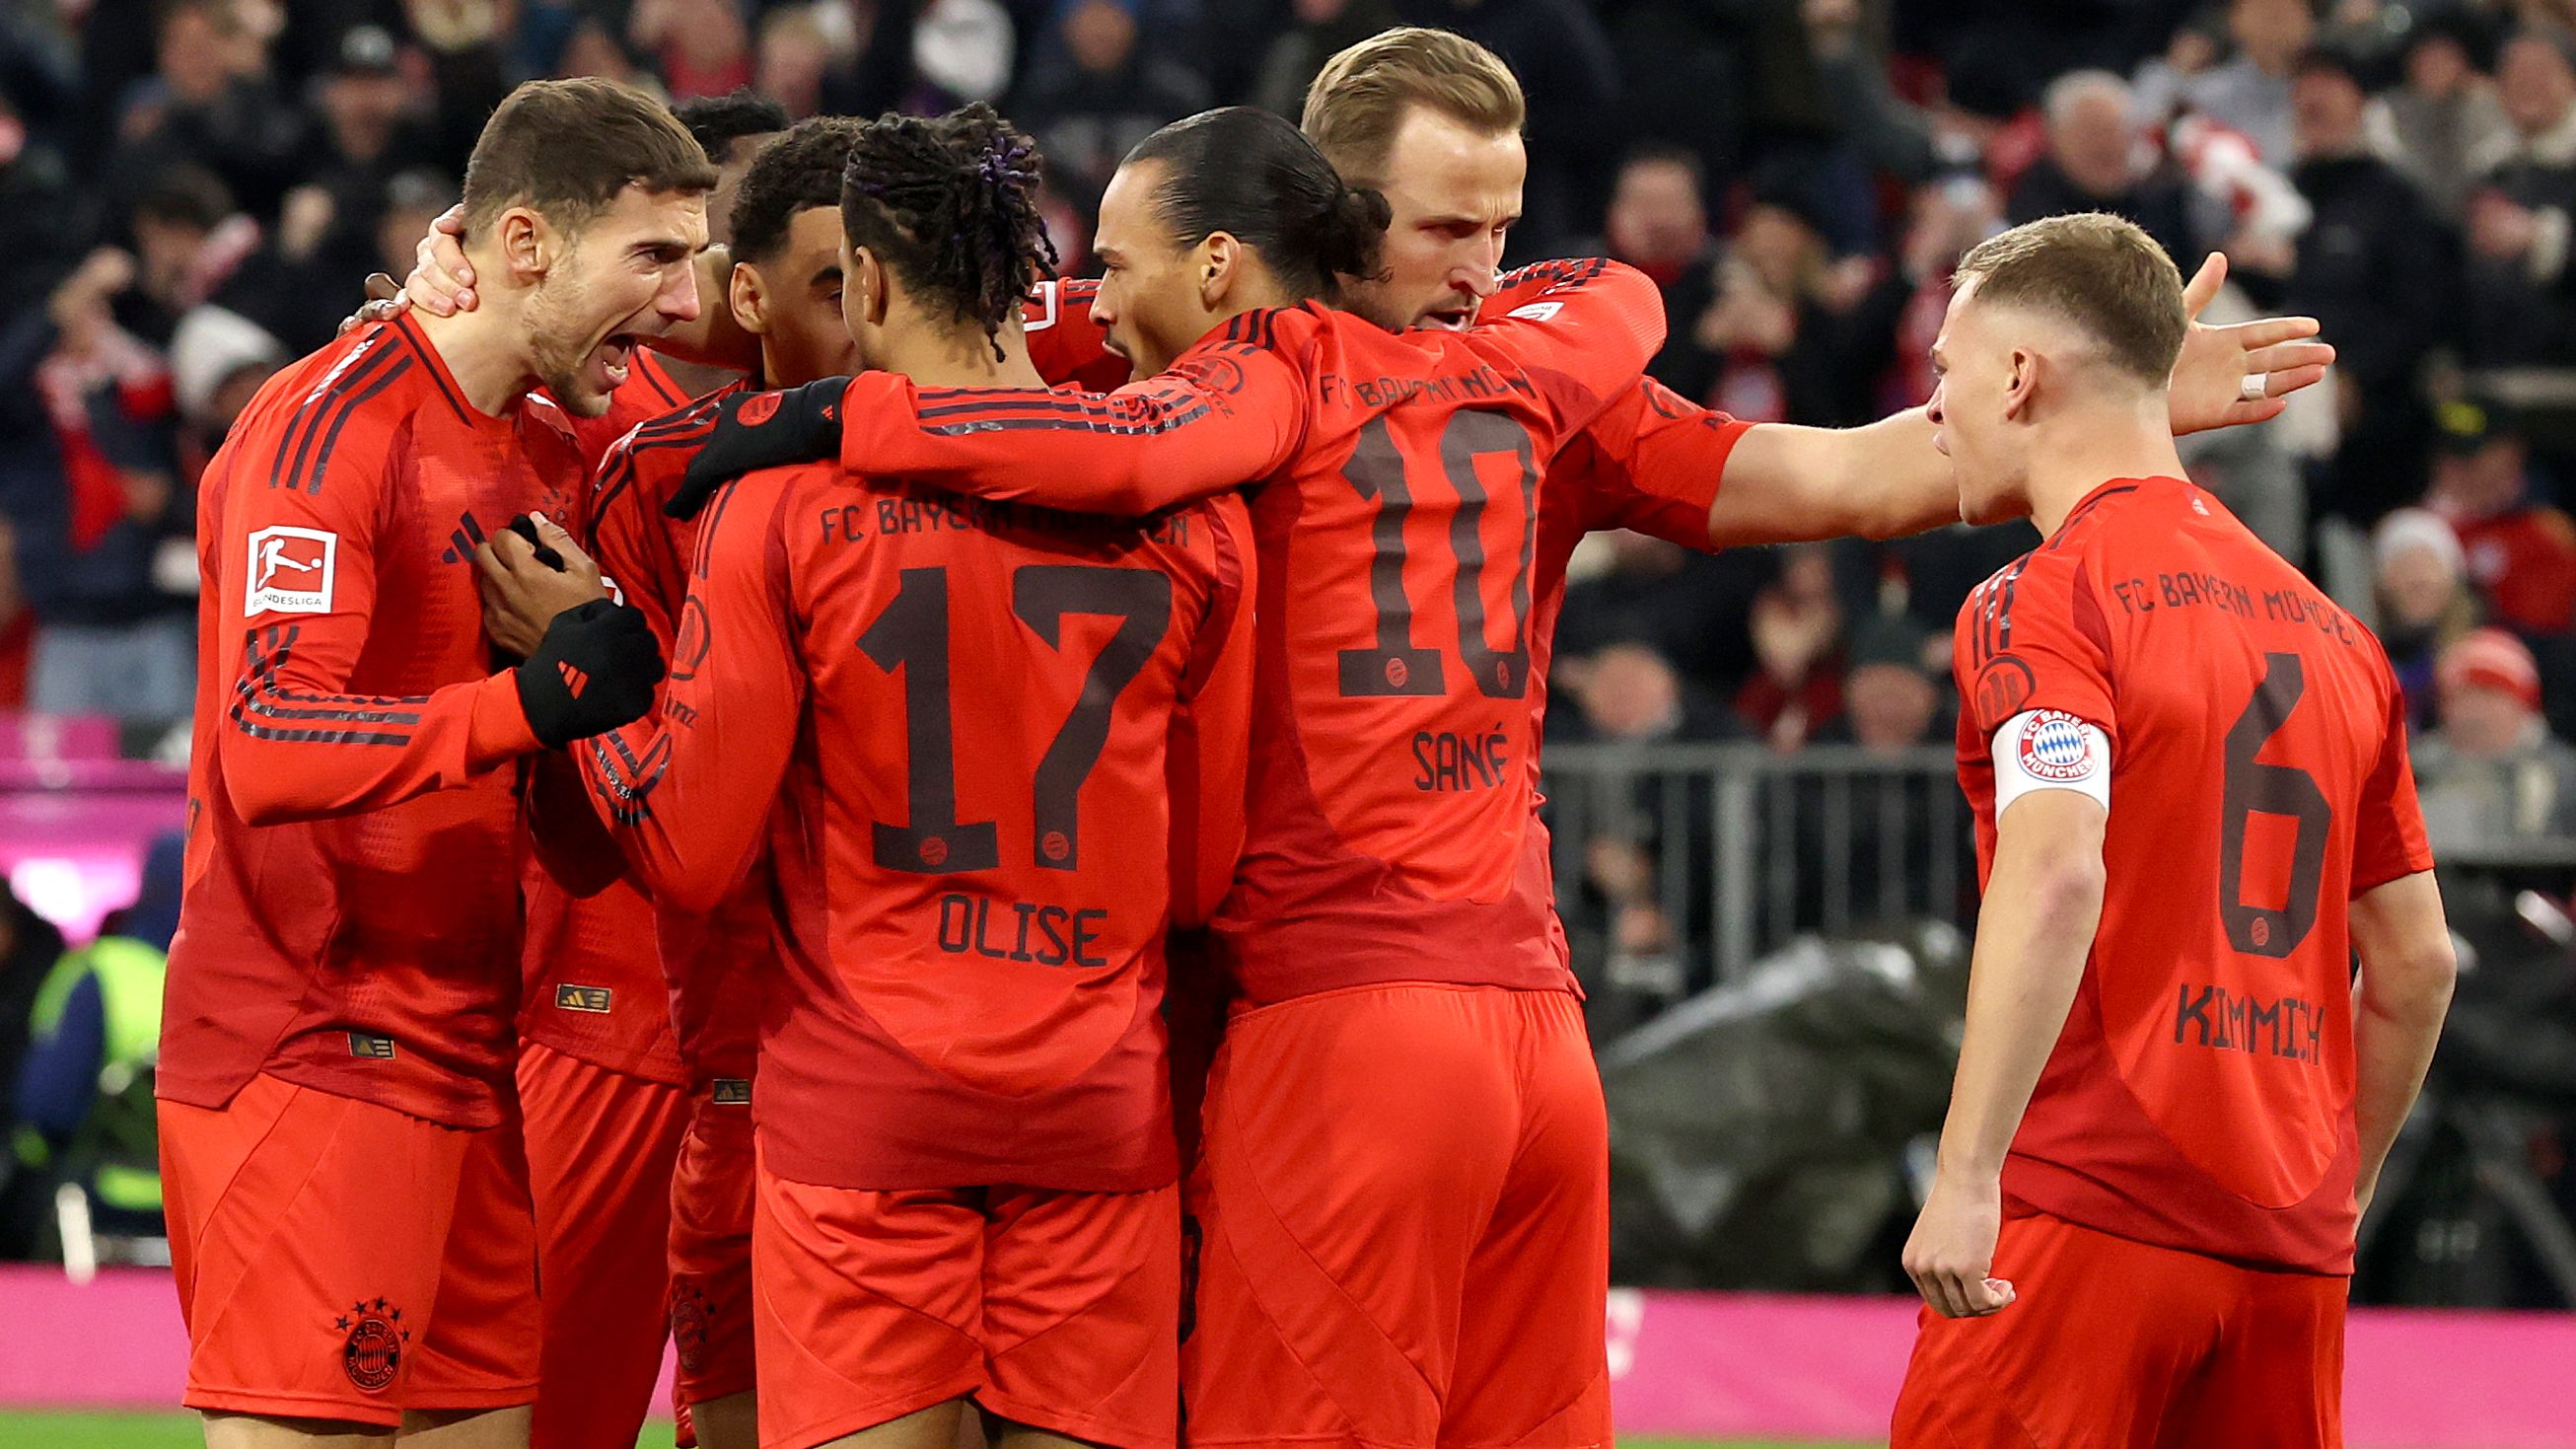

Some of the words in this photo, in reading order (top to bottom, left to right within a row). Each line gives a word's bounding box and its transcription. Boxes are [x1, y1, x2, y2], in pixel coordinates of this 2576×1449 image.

[821, 505, 864, 545] FC
[1338, 408, 1537, 699] 10
[2113, 578, 2155, 614] FC
[2159, 572, 2256, 619] BAYERN
[2262, 590, 2357, 647] MÜNCE
[855, 565, 1172, 874] 17
[1412, 721, 1508, 792] SANÉ
[2023, 720, 2039, 740] FC
[2219, 652, 2331, 959] 6
[938, 894, 1108, 968] OLISE
